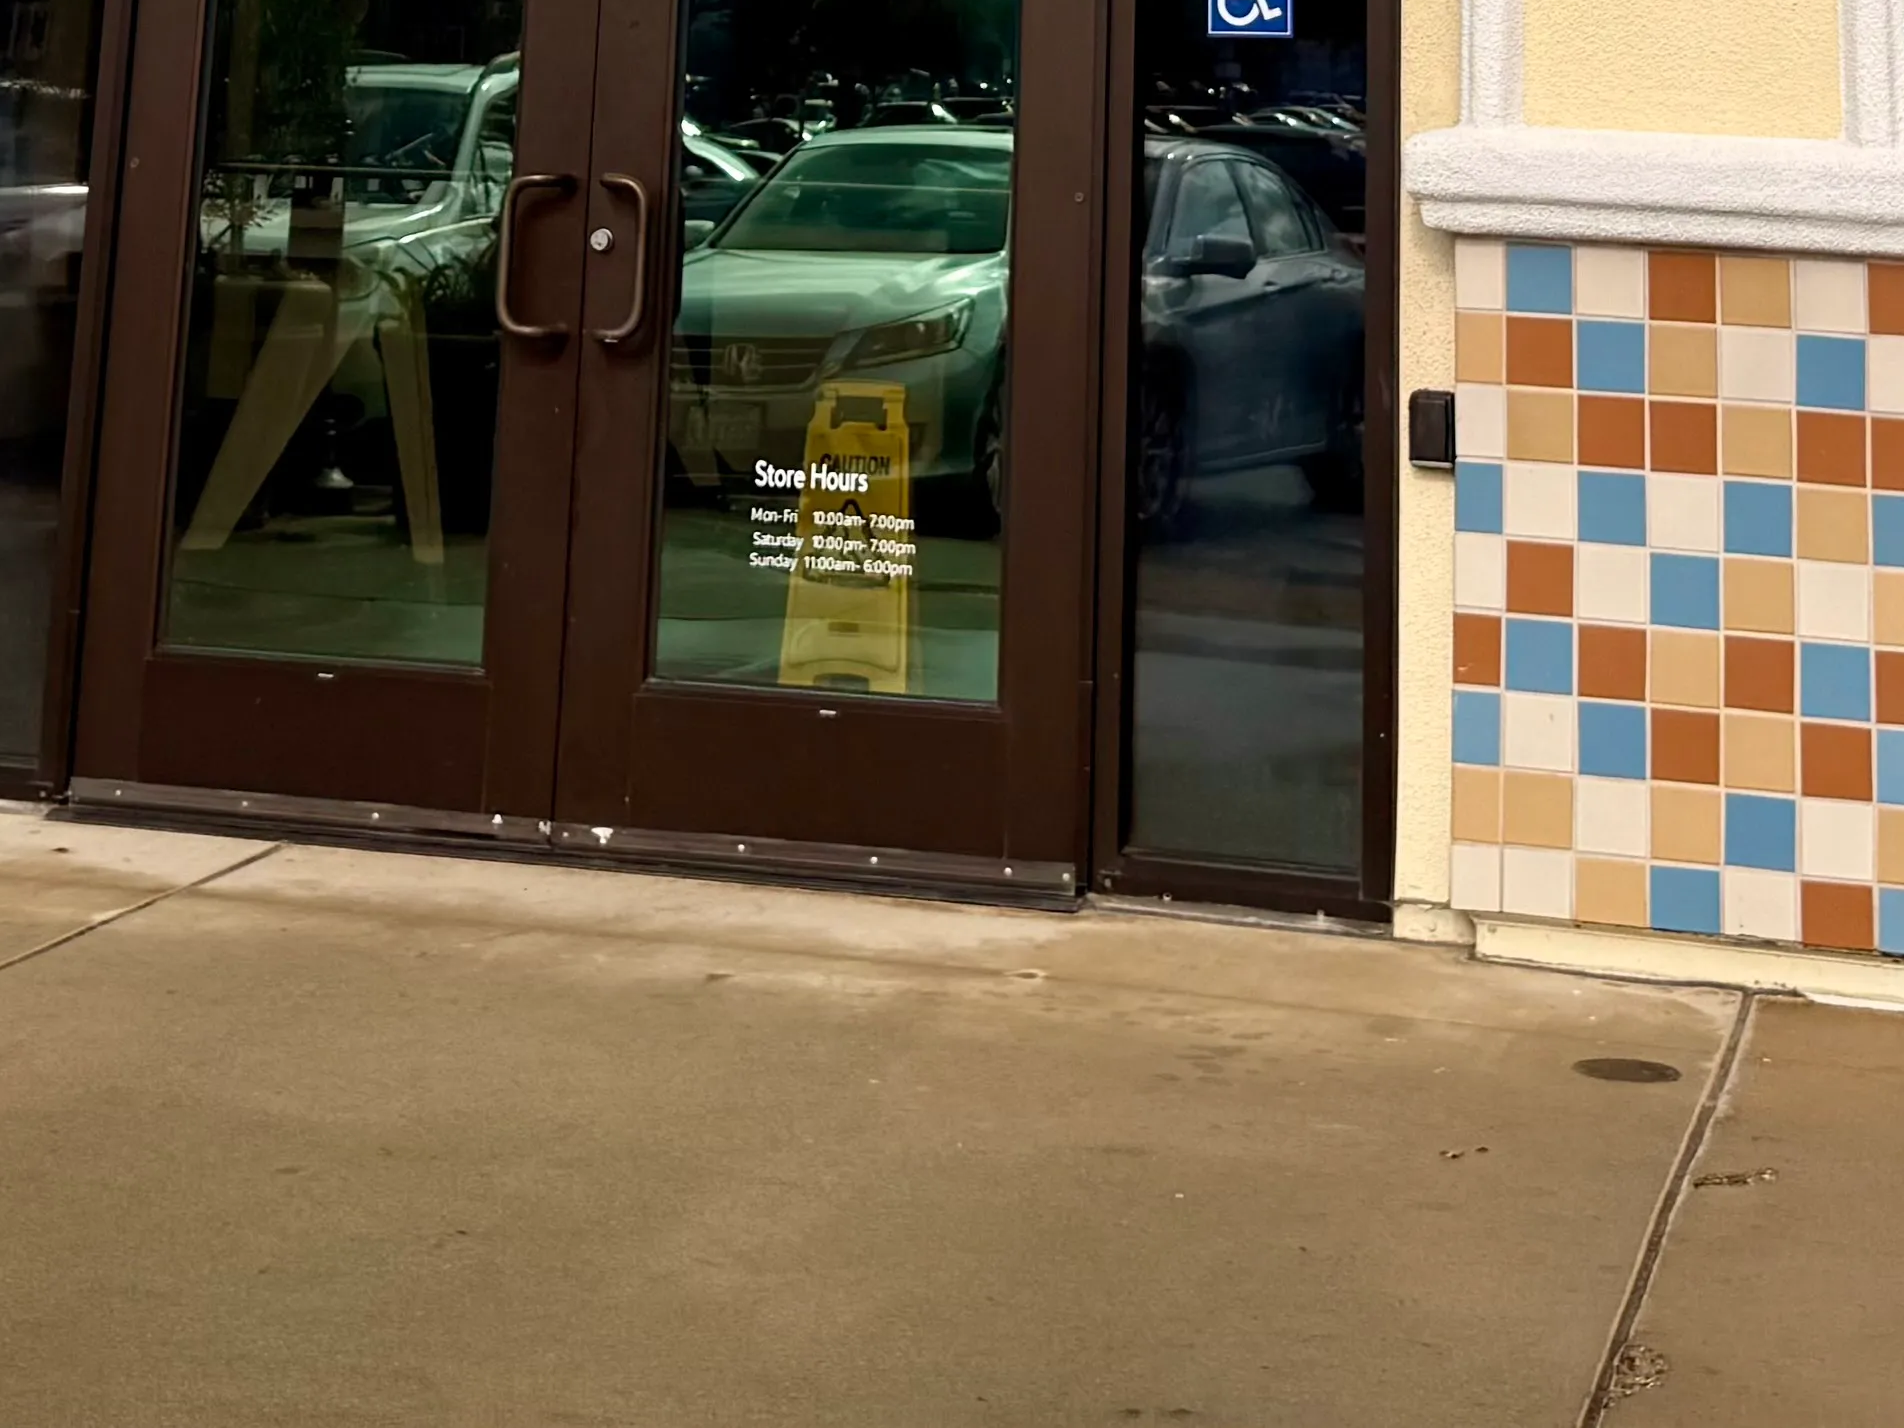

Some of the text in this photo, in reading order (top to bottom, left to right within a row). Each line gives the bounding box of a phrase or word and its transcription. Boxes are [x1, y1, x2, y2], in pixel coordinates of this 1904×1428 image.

[754, 459, 868, 492] Store Hours
[750, 507, 799, 524] Mon-Fri
[752, 531, 805, 551] Saturday
[749, 552, 798, 572] Sunday
